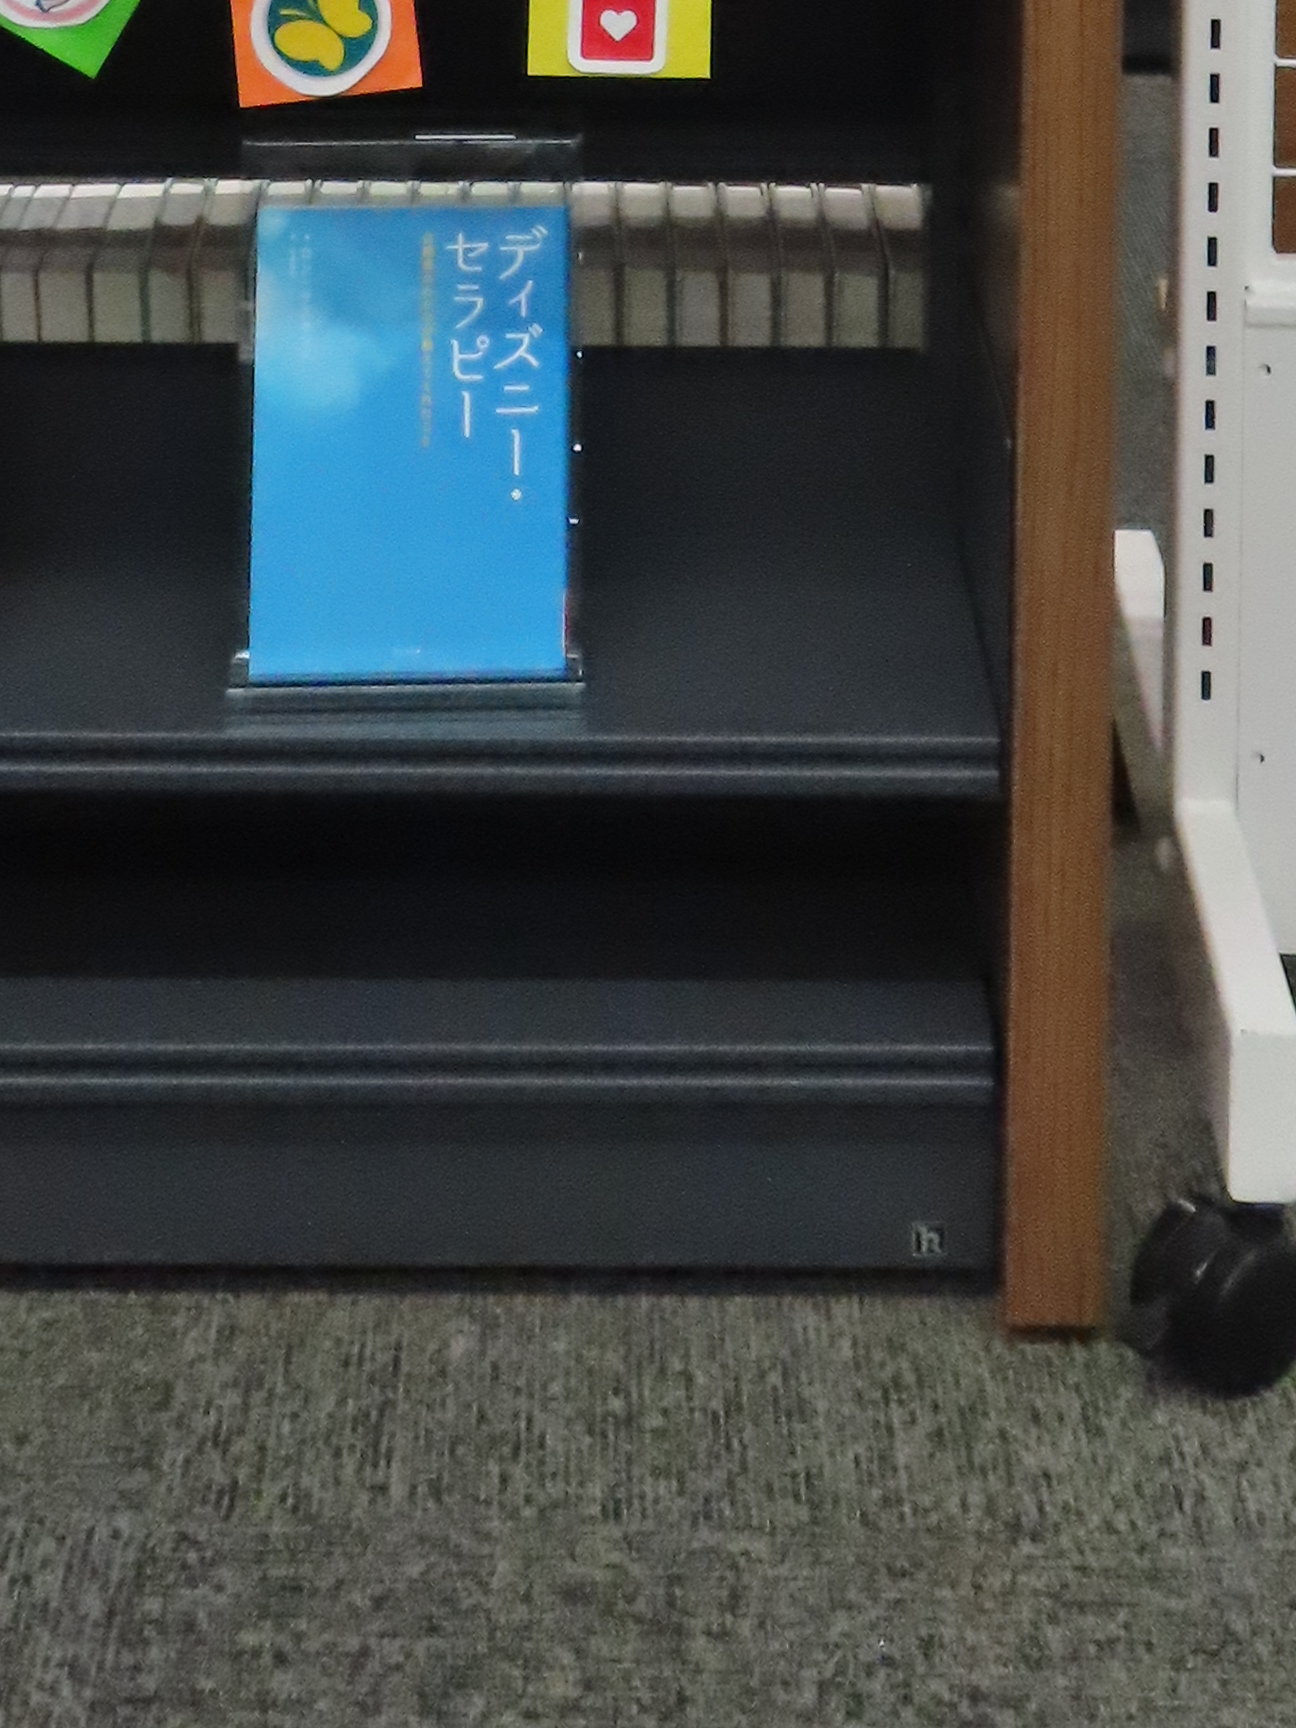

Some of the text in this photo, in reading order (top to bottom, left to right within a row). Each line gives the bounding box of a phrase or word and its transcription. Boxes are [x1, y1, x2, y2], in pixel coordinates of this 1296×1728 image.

[445, 232, 490, 440] セラピー
[494, 224, 548, 502] ディズニー・
